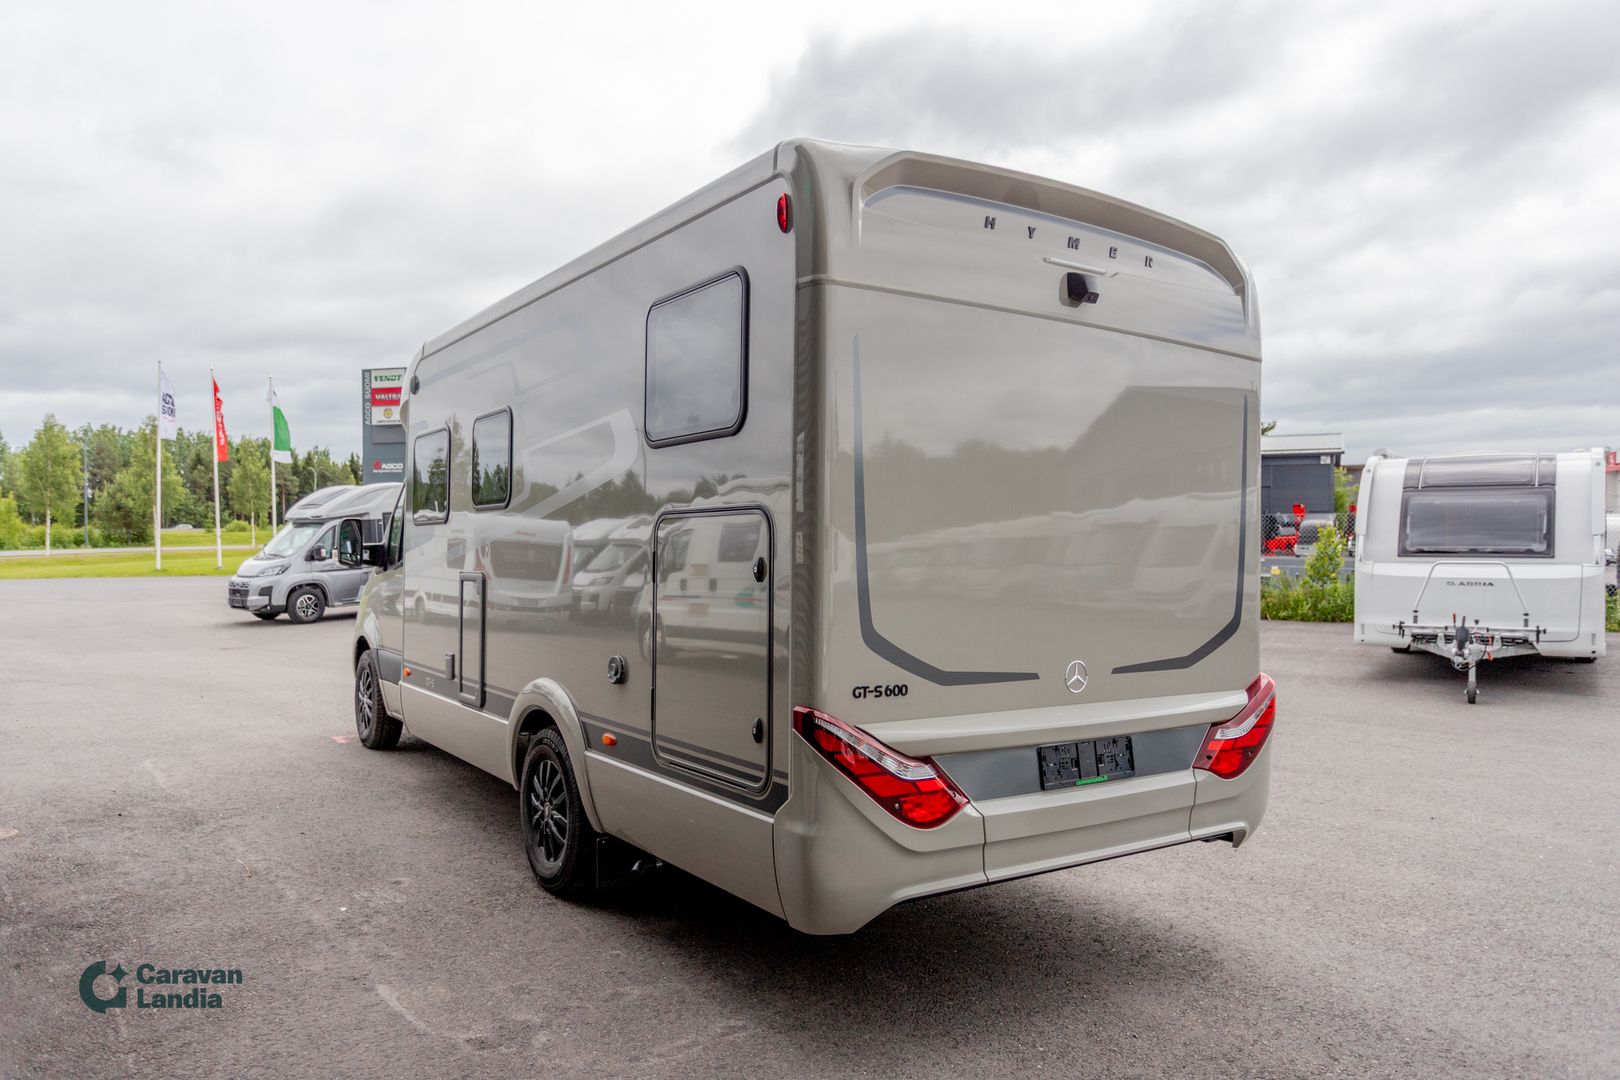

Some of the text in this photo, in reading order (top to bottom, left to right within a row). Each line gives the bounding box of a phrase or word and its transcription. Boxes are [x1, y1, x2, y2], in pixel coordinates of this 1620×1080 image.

[984, 216, 1153, 268] HYMER
[852, 684, 908, 699] GT-S 600
